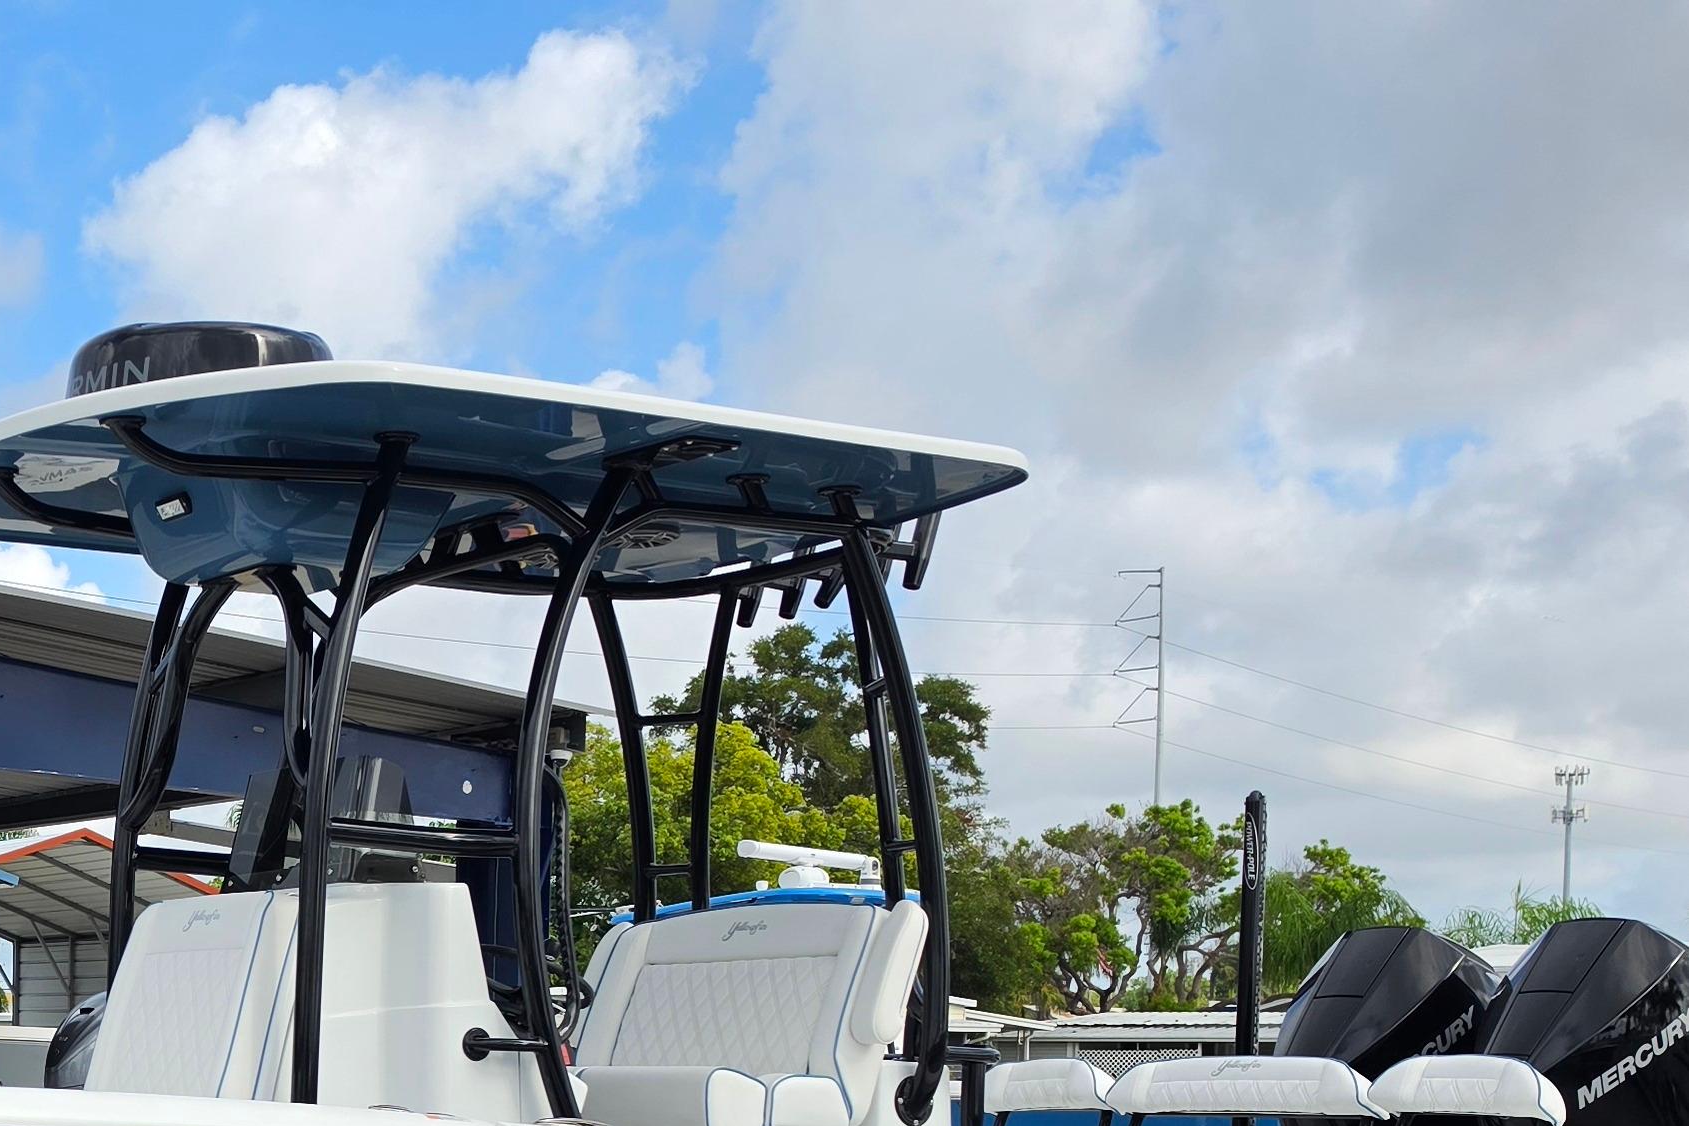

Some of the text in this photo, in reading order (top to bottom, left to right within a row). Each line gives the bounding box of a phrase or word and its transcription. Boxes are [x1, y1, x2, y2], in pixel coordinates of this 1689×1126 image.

[70, 356, 151, 396] RMIN
[1245, 821, 1256, 881] POWER-POLE
[1420, 1004, 1475, 1055] CURY
